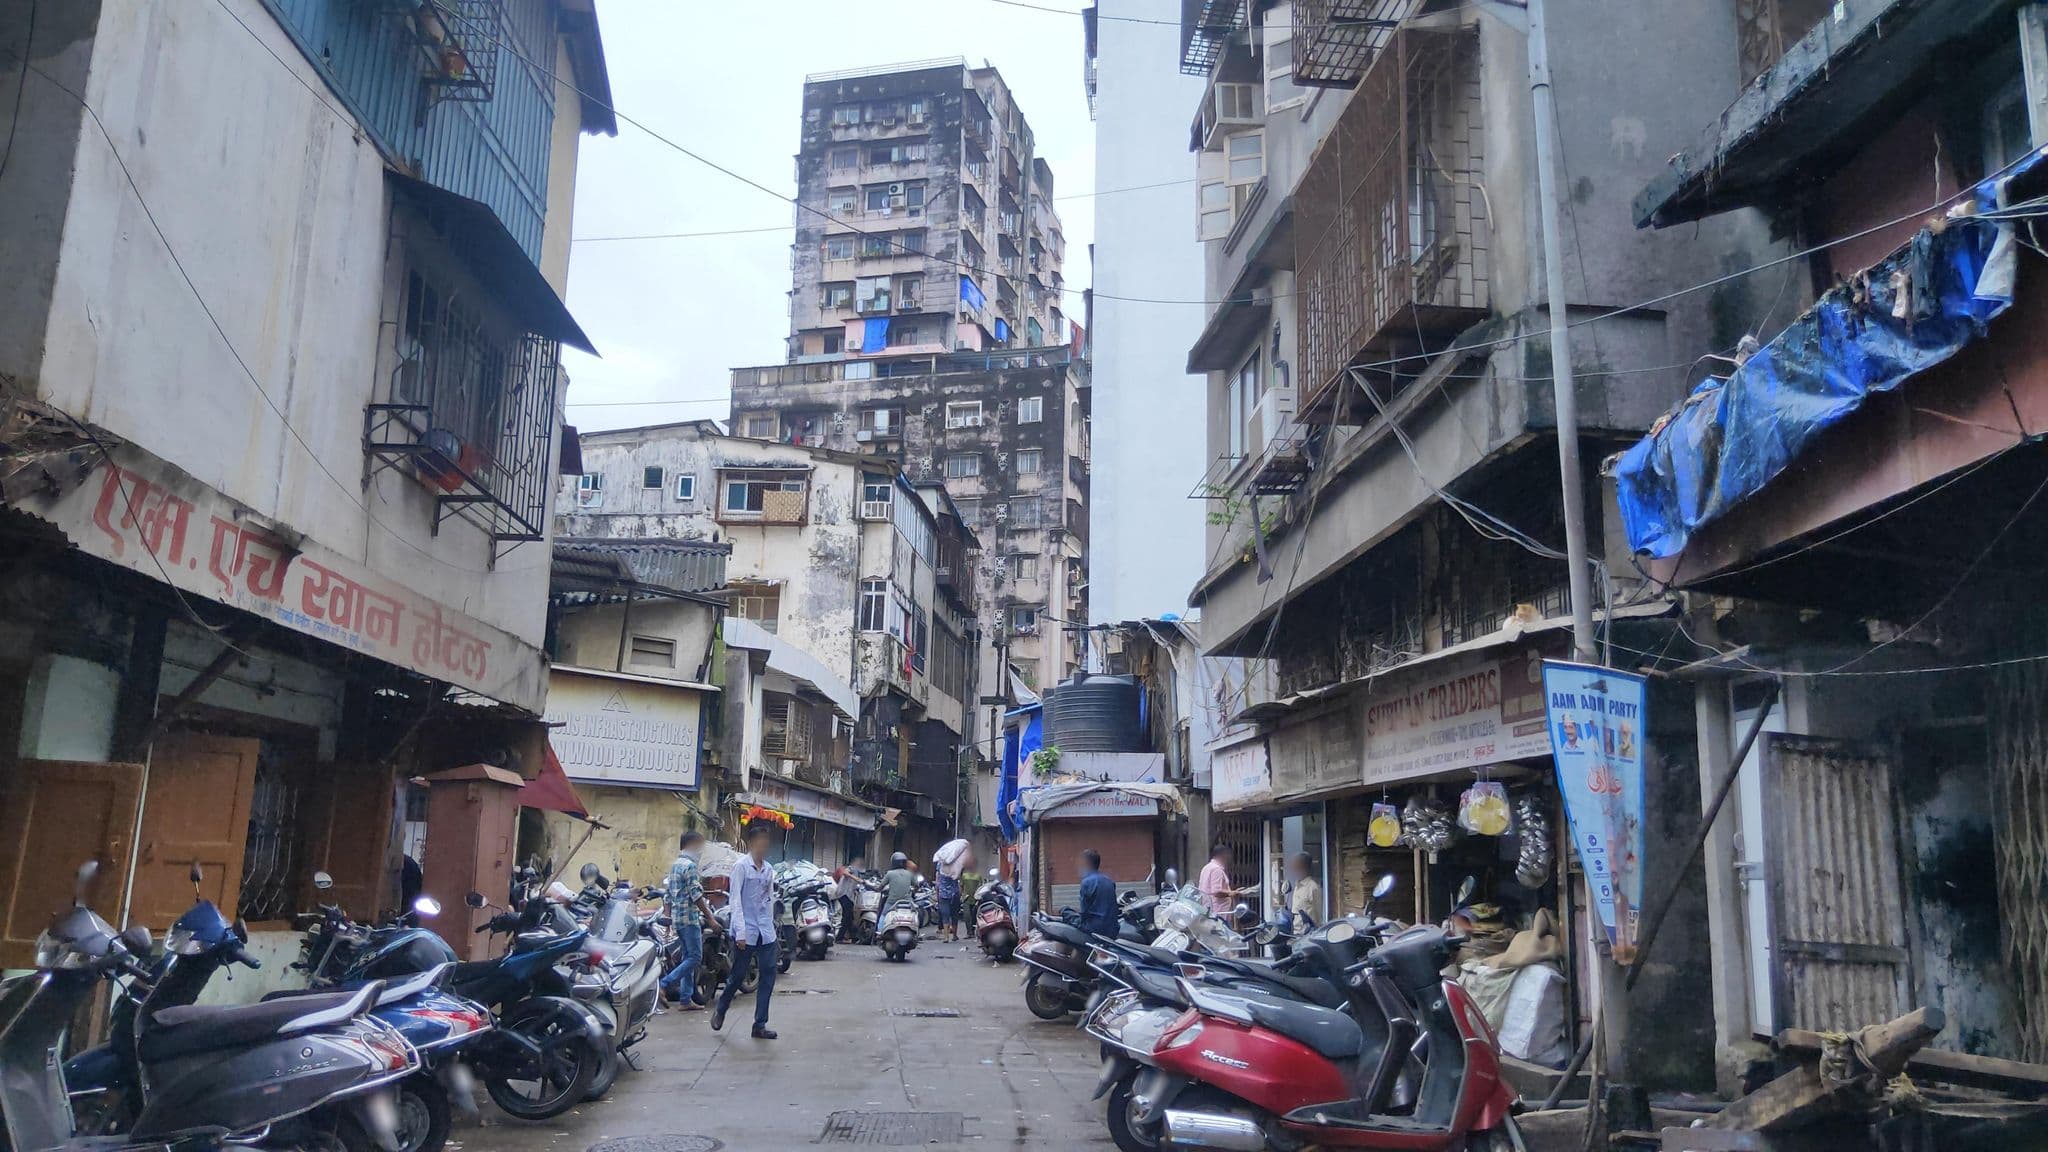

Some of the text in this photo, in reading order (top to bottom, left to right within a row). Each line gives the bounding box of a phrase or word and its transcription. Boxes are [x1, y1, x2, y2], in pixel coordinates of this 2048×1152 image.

[301, 557, 405, 649] खान
[411, 602, 492, 682] होटल
[1428, 669, 1499, 722] TRADERS
[1552, 692, 1577, 710] AAM
[1609, 699, 1638, 719] PARTY
[582, 713, 694, 747] INFRASTRUCTURES
[569, 741, 615, 768] WOOD
[616, 747, 691, 774] PRODUCTS
[1200, 1049, 1250, 1069] Access
